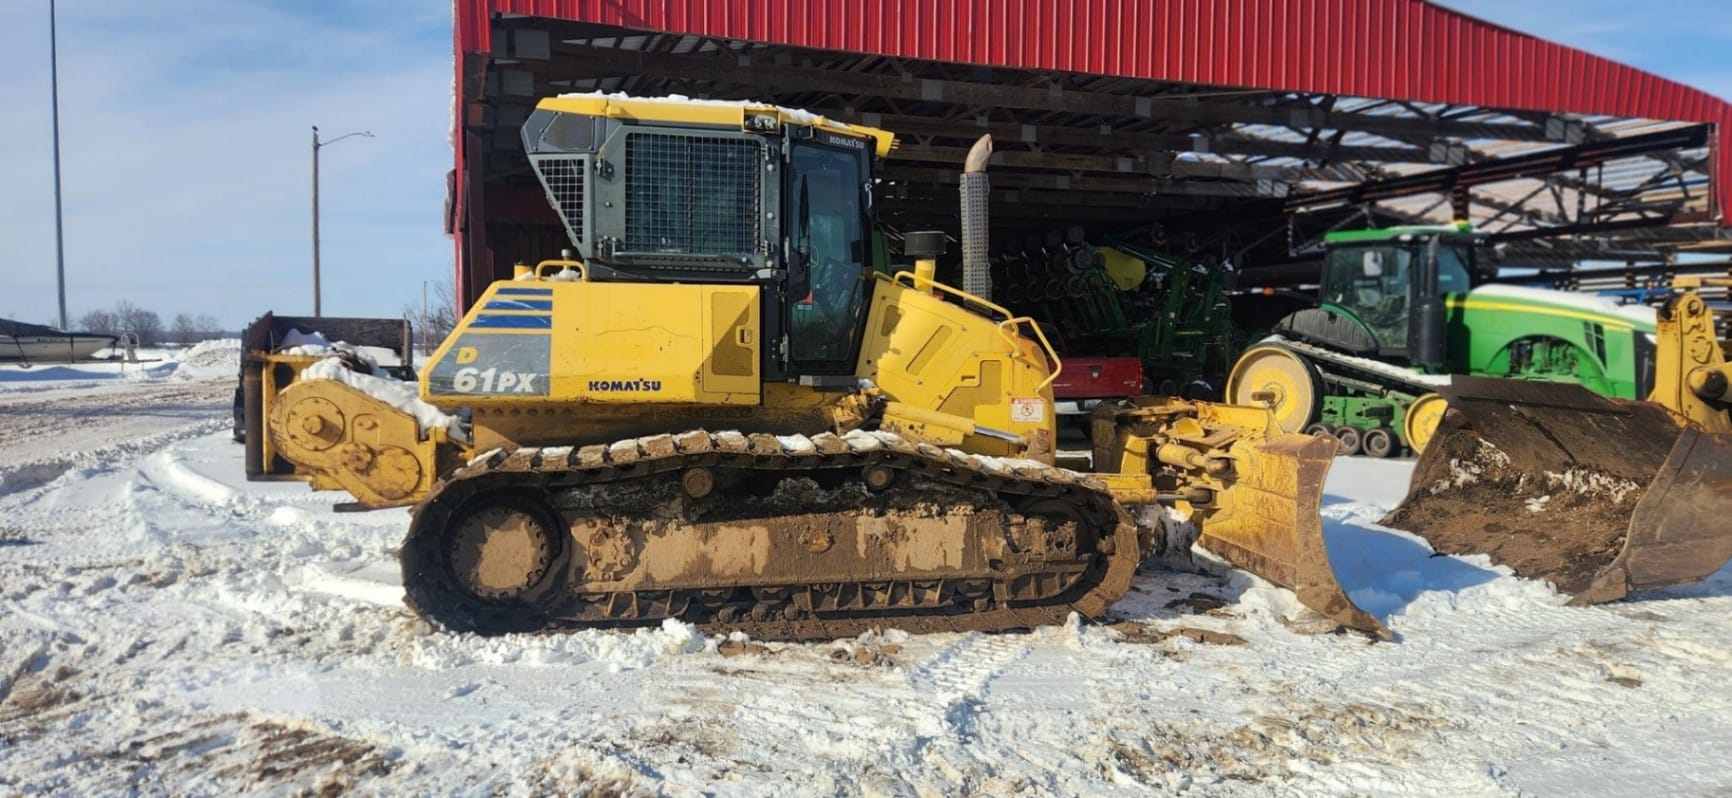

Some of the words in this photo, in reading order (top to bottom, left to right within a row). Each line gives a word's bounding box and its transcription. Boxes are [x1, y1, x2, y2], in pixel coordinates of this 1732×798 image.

[829, 136, 865, 149] KOMATSU
[456, 347, 478, 365] D
[453, 367, 537, 393] 61PX
[589, 378, 661, 391] KOMATSU
